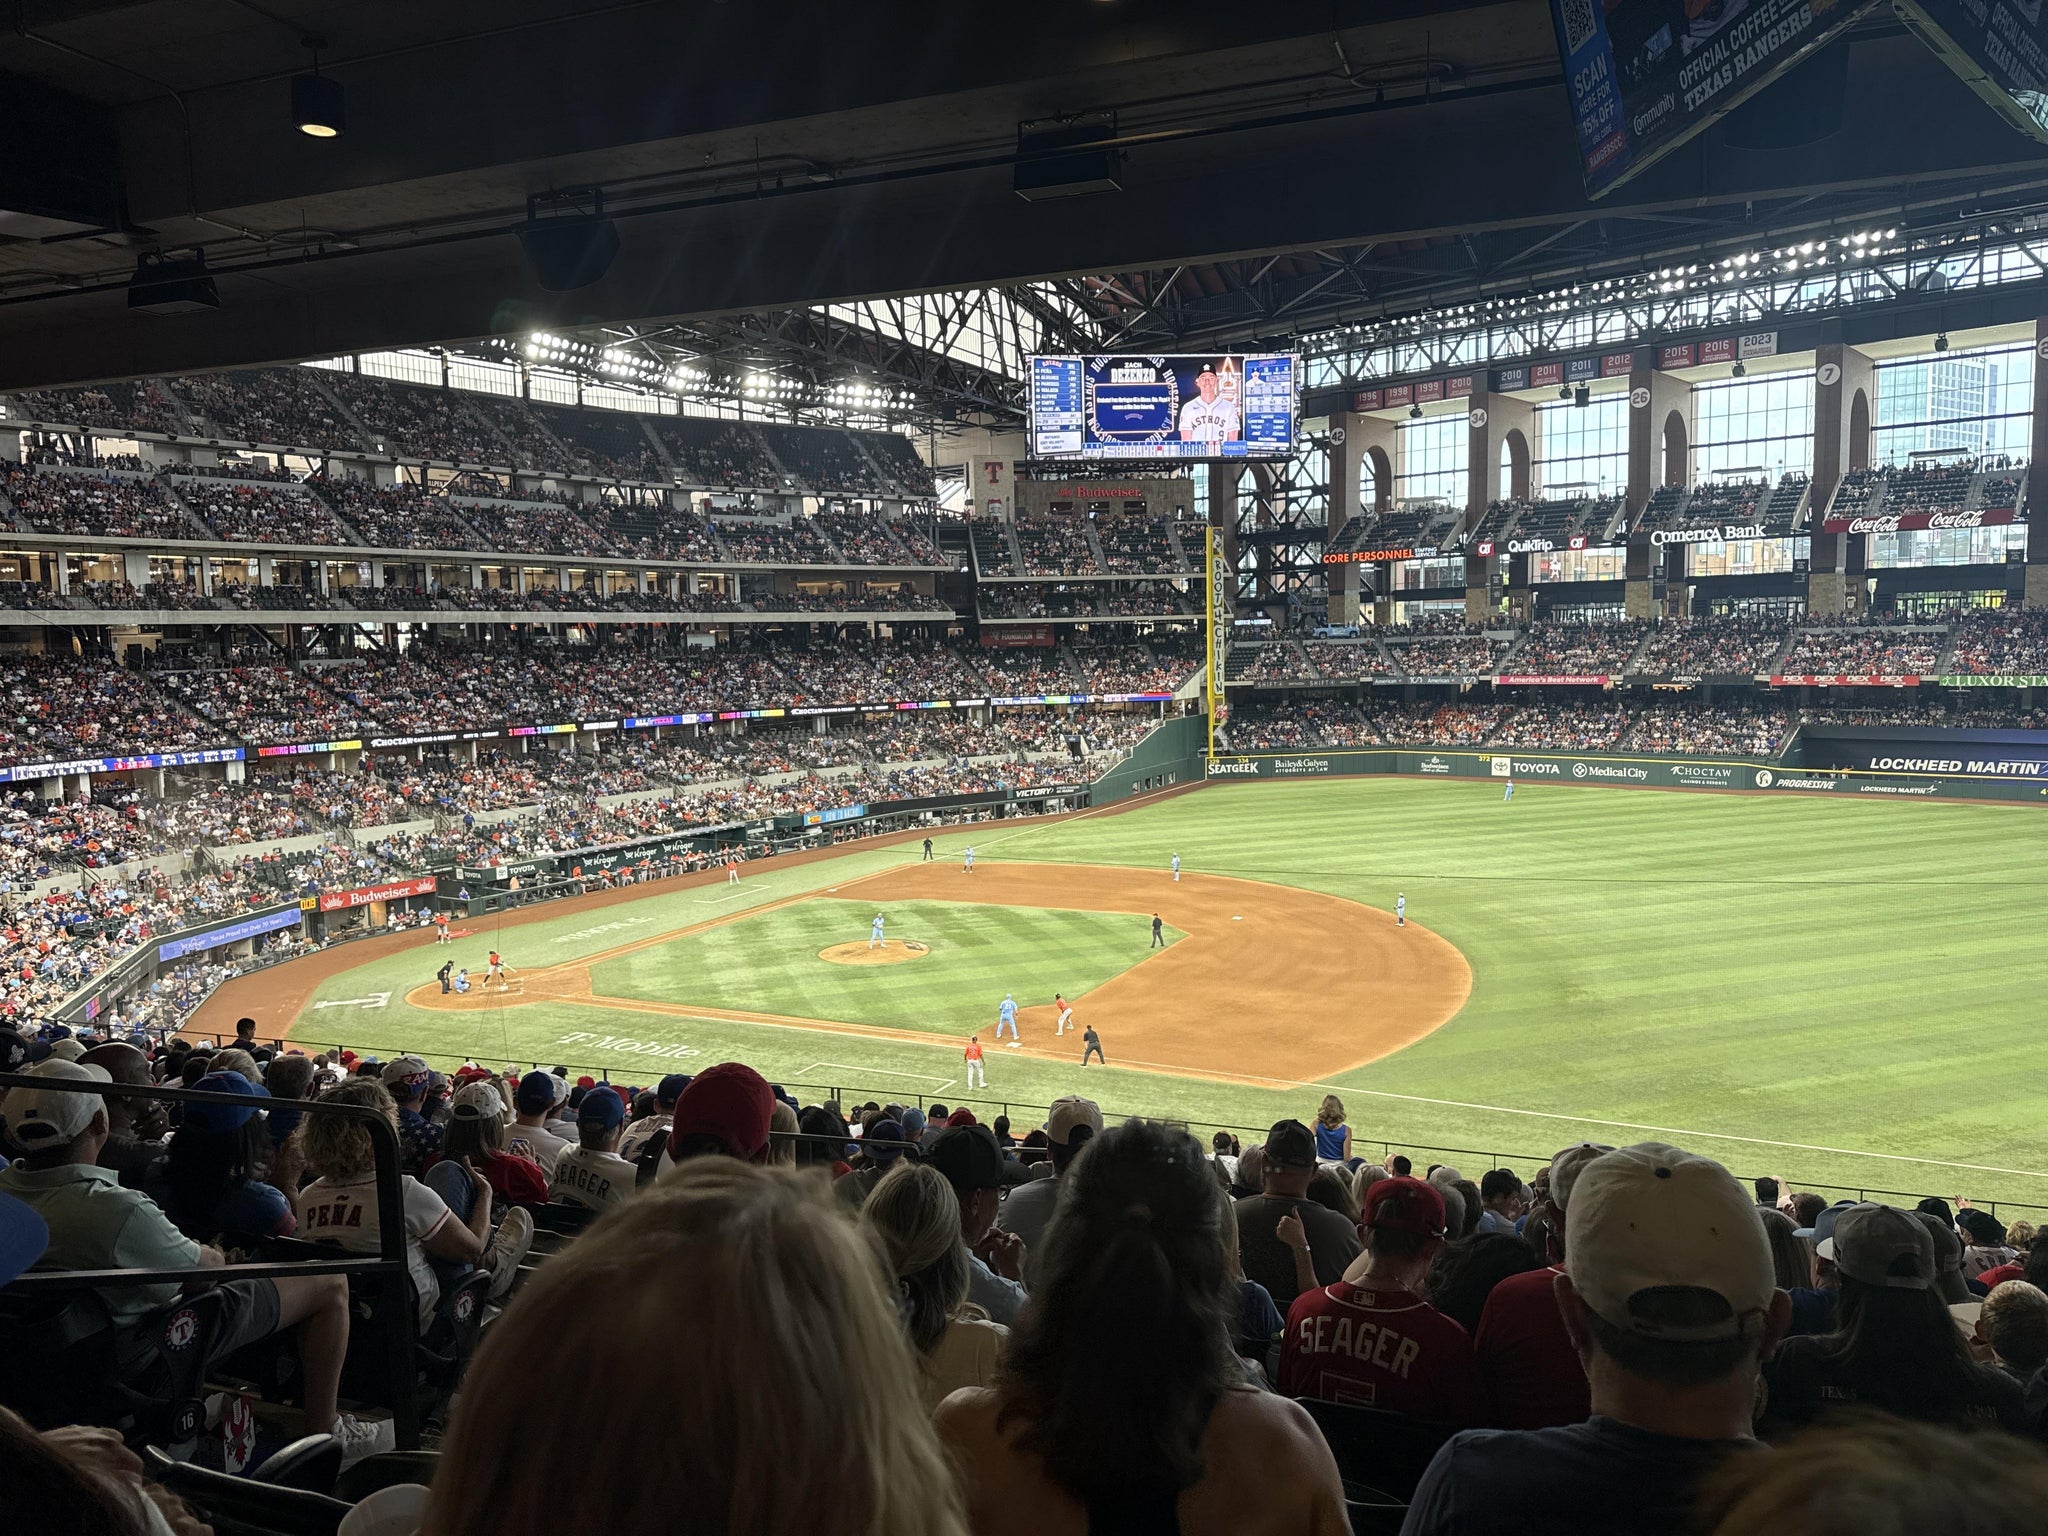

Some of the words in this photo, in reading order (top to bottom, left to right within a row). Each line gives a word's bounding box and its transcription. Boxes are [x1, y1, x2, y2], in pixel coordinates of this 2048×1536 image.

[1680, 39, 1729, 89] OFFICIAL
[1730, 0, 1778, 50] COFFEE
[1684, 64, 1732, 112] TEXAS
[1734, 3, 1813, 77] RANGERS
[1574, 51, 1608, 98] SCAN
[1579, 92, 1597, 118] HERE
[1597, 81, 1611, 102] FOR
[1583, 112, 1599, 136] 15%
[1599, 98, 1615, 123] OFF
[1634, 92, 1674, 135] Community
[1705, 340, 1729, 352] 2016
[1744, 334, 1772, 347] 2023
[1665, 346, 1688, 358] 2015
[1571, 360, 1591, 371] 2011
[1608, 354, 1630, 366] 2012
[1111, 368, 1156, 383] DEZENZO
[1501, 370, 1522, 381] 2010
[1537, 365, 1556, 376] 2011
[1824, 368, 1834, 381] 7
[1420, 382, 1439, 393] 1999
[1452, 377, 1472, 388] 2010
[1359, 391, 1377, 402] 1996
[1390, 386, 1408, 398] 1998
[1632, 391, 1649, 404] 26
[1191, 415, 1226, 430] ASTROS
[1472, 412, 1486, 424] 34
[1331, 432, 1344, 442] 42
[985, 462, 1003, 483] T
[1077, 485, 1139, 497] Budweiser
[1849, 516, 1902, 534] Coca-Cola
[1929, 511, 1984, 528] Coca-Cola
[1725, 524, 1767, 540] Bank
[1508, 539, 1553, 553] QuikTrip
[1323, 553, 1349, 565] CORE
[1352, 548, 1414, 562] PERSONNEL
[1214, 612, 1223, 623] 4
[1215, 627, 1223, 693] CHIKIN
[1956, 675, 2015, 687] LUXOR
[371, 738, 413, 748] CHOCTAW
[1208, 762, 1259, 774] SEATGEEK
[1513, 763, 1560, 774] TOYOTA
[1672, 765, 1731, 777] CHOCTAW
[1870, 757, 1962, 772] LOCKHEED
[1966, 761, 2040, 775] MARTIN
[1589, 766, 1626, 777] Medical
[1628, 768, 1648, 780] City
[1776, 779, 1836, 790] PROGRESSIVE
[1016, 787, 1051, 798] VICTORY
[634, 847, 657, 860] Kroger
[672, 840, 694, 854] Kroger
[594, 853, 618, 868] Kroger
[509, 865, 535, 874] TOYOTA
[350, 886, 410, 904] Budweiser
[226, 930, 240, 939] Proud
[270, 918, 282, 926] Years
[555, 1163, 610, 1201] SEAGER
[307, 1195, 362, 1229] PEÑA
[1300, 1316, 1419, 1379] SEAGER
[182, 1412, 194, 1430] 16
